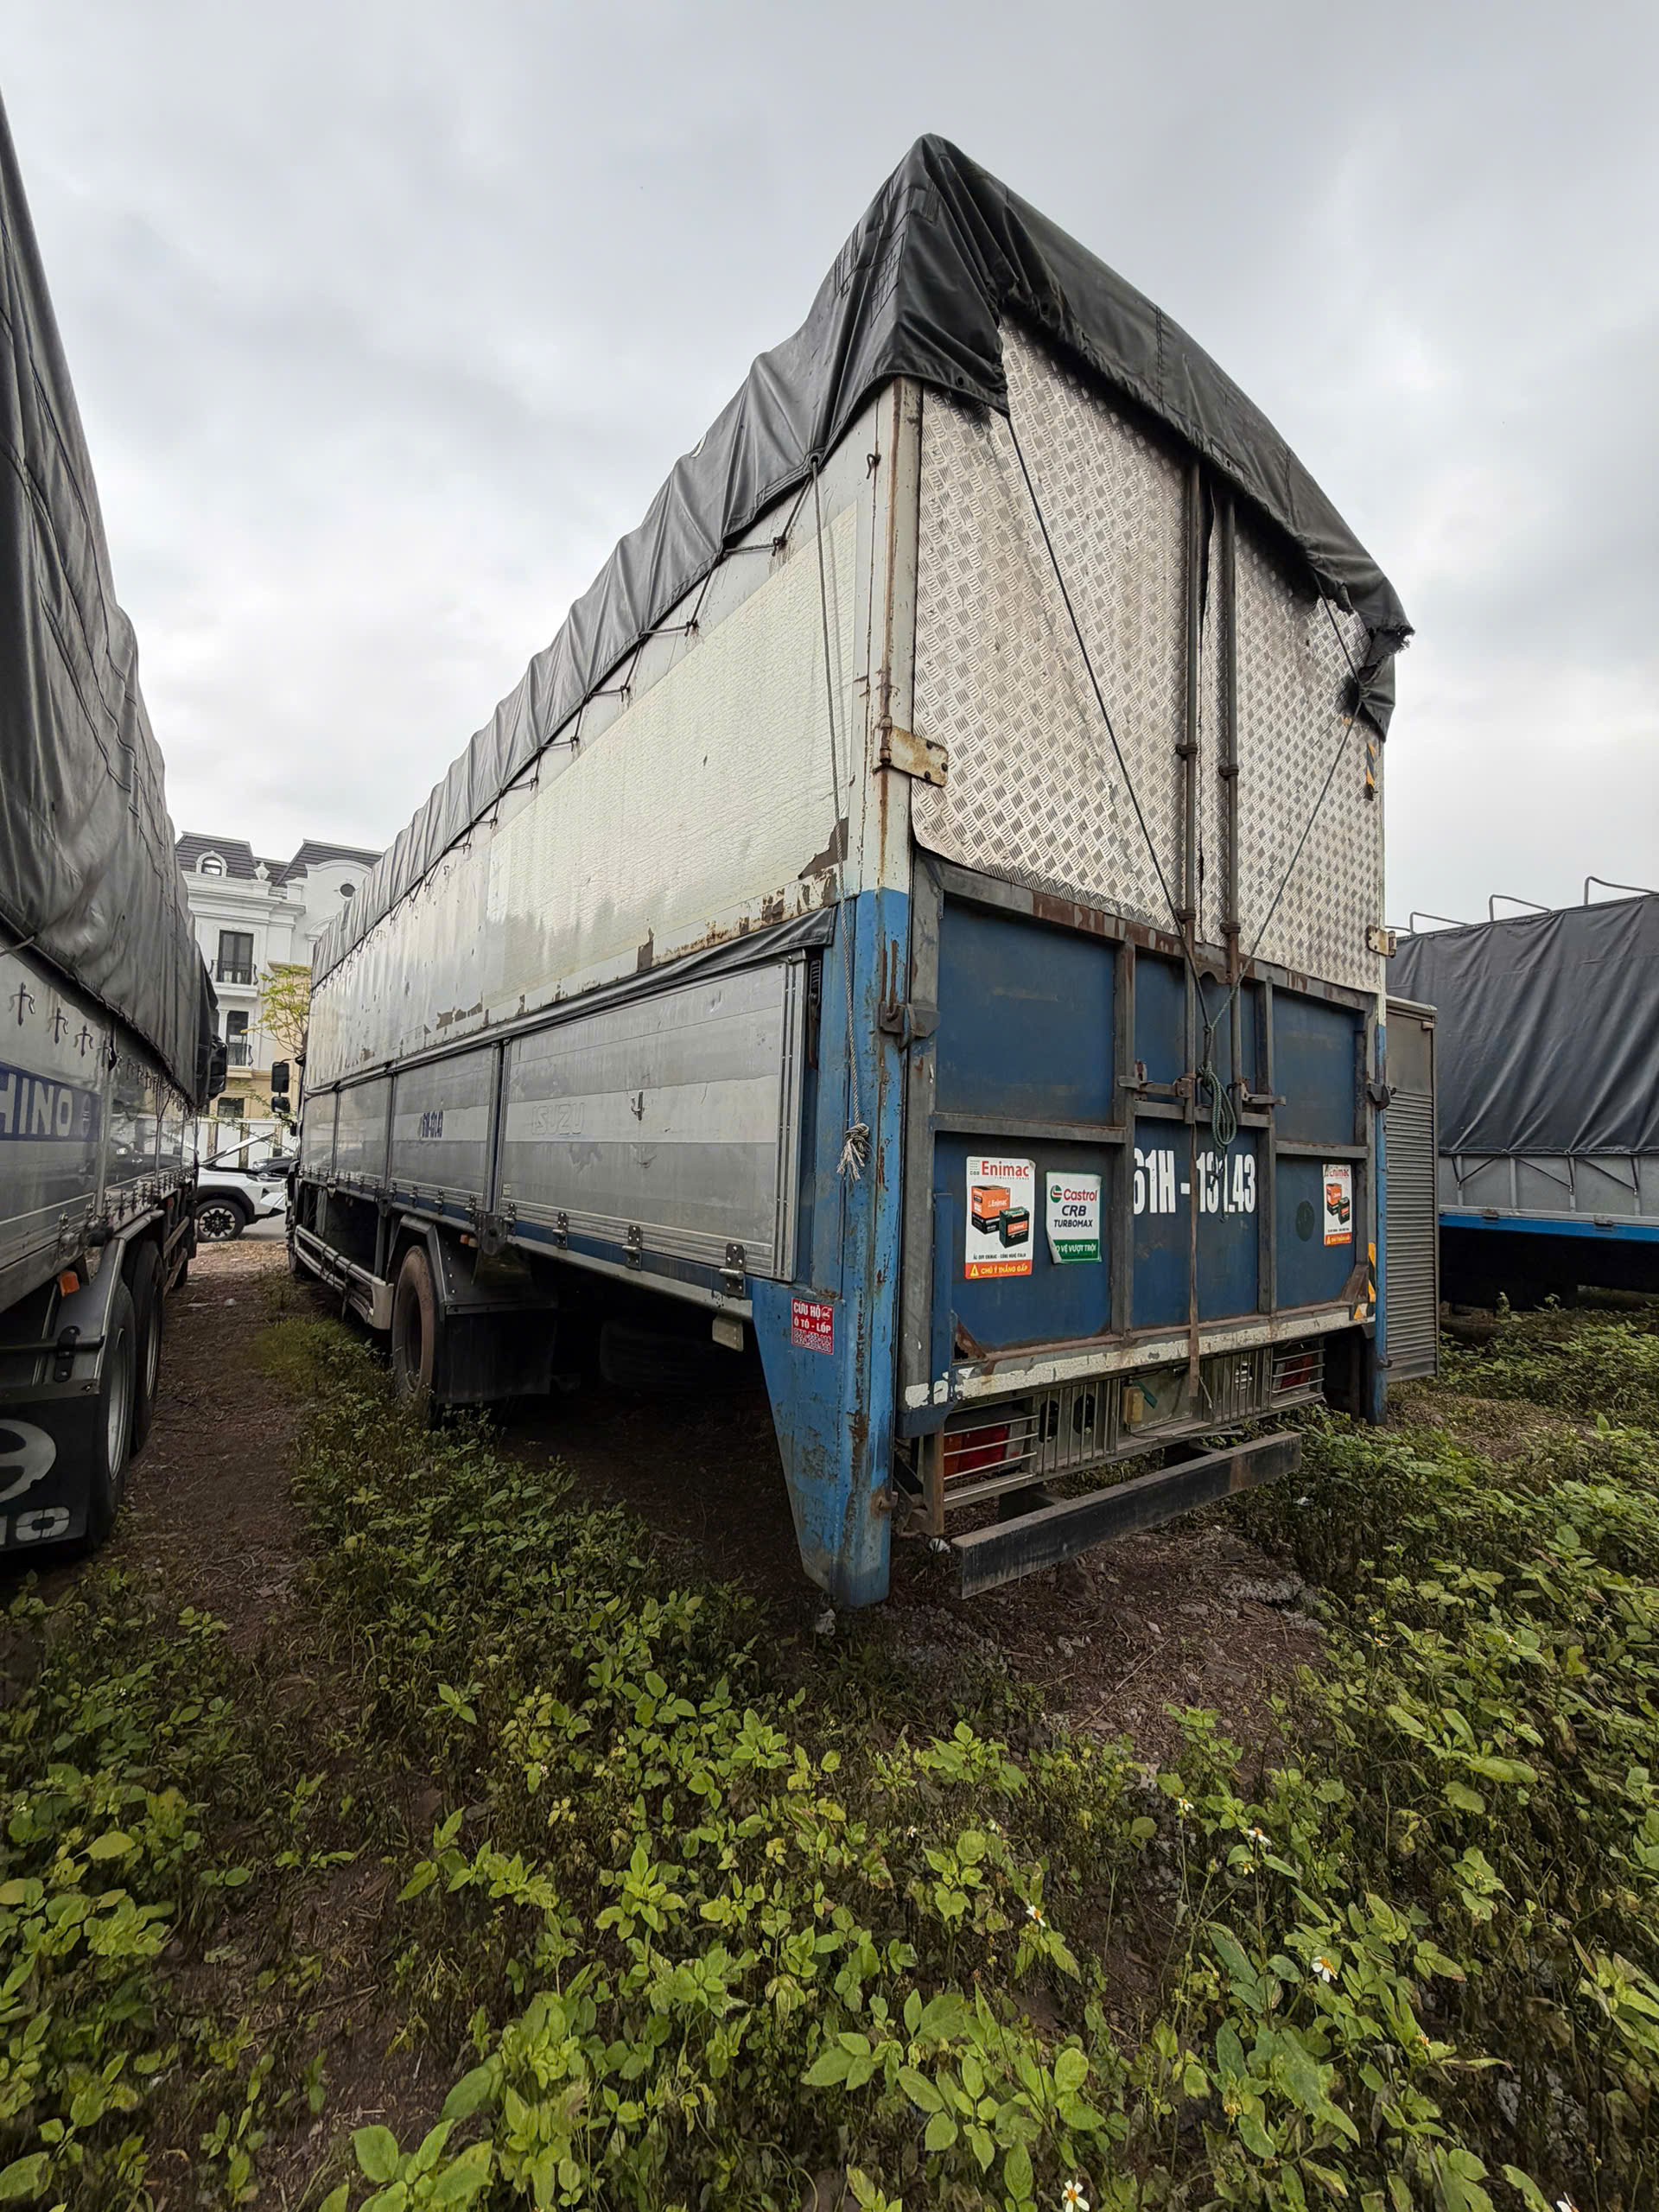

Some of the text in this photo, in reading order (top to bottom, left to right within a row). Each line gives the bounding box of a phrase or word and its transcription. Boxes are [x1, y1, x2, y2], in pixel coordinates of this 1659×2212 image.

[531, 1102, 586, 1135] ISUZU
[982, 1160, 1029, 1177] Enimac
[1063, 1188, 1097, 1201] Castrol
[1061, 1205, 1087, 1217] CRB
[1053, 1219, 1093, 1228] TURBOMAX
[810, 1305, 821, 1320] HỘ
